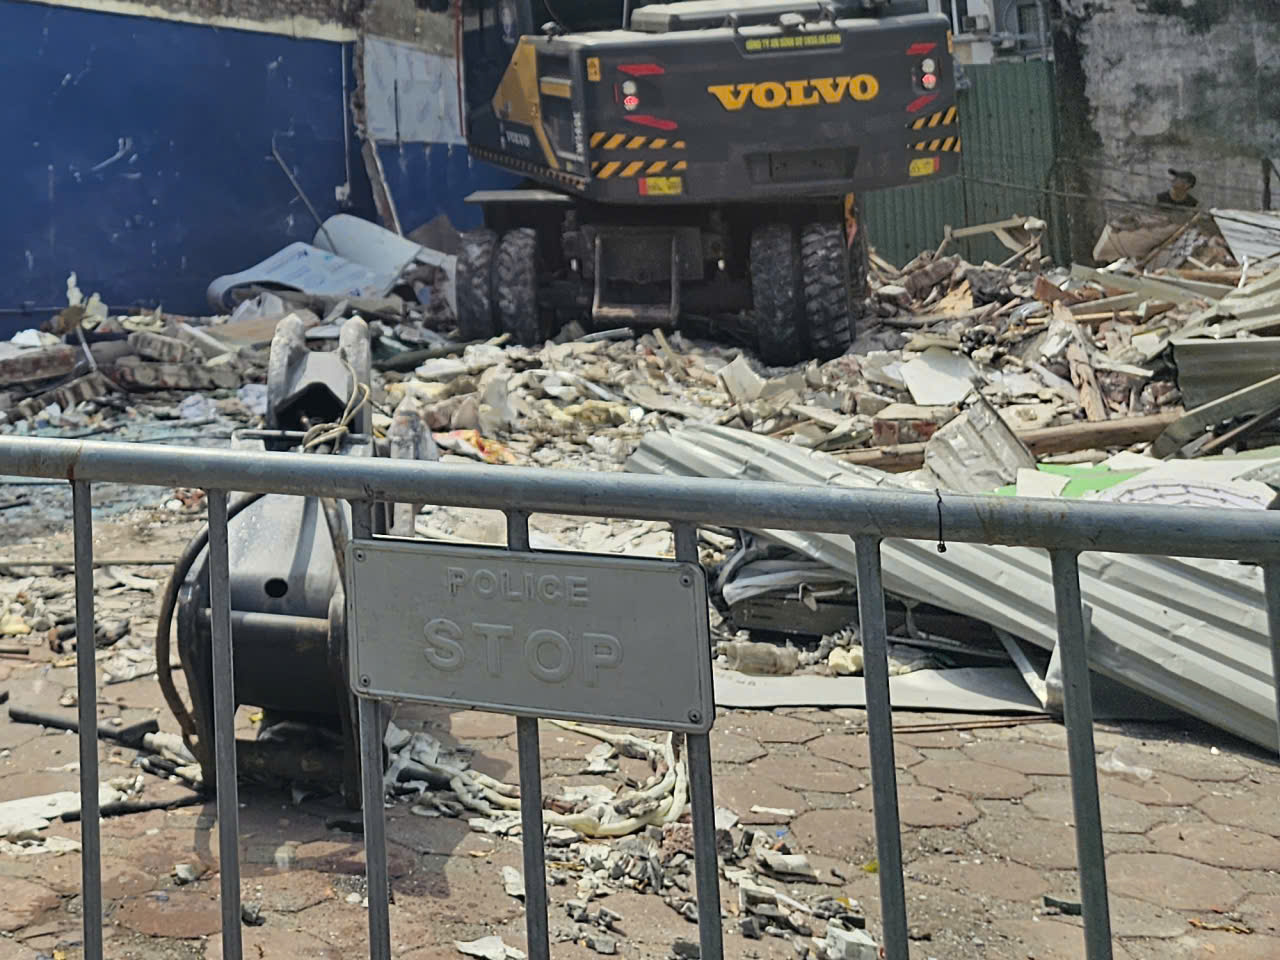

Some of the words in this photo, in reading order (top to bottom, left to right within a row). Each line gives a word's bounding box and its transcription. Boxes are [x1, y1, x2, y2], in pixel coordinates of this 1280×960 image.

[708, 73, 880, 111] VOLVO
[446, 566, 591, 608] POLICE
[423, 617, 623, 689] STOP
